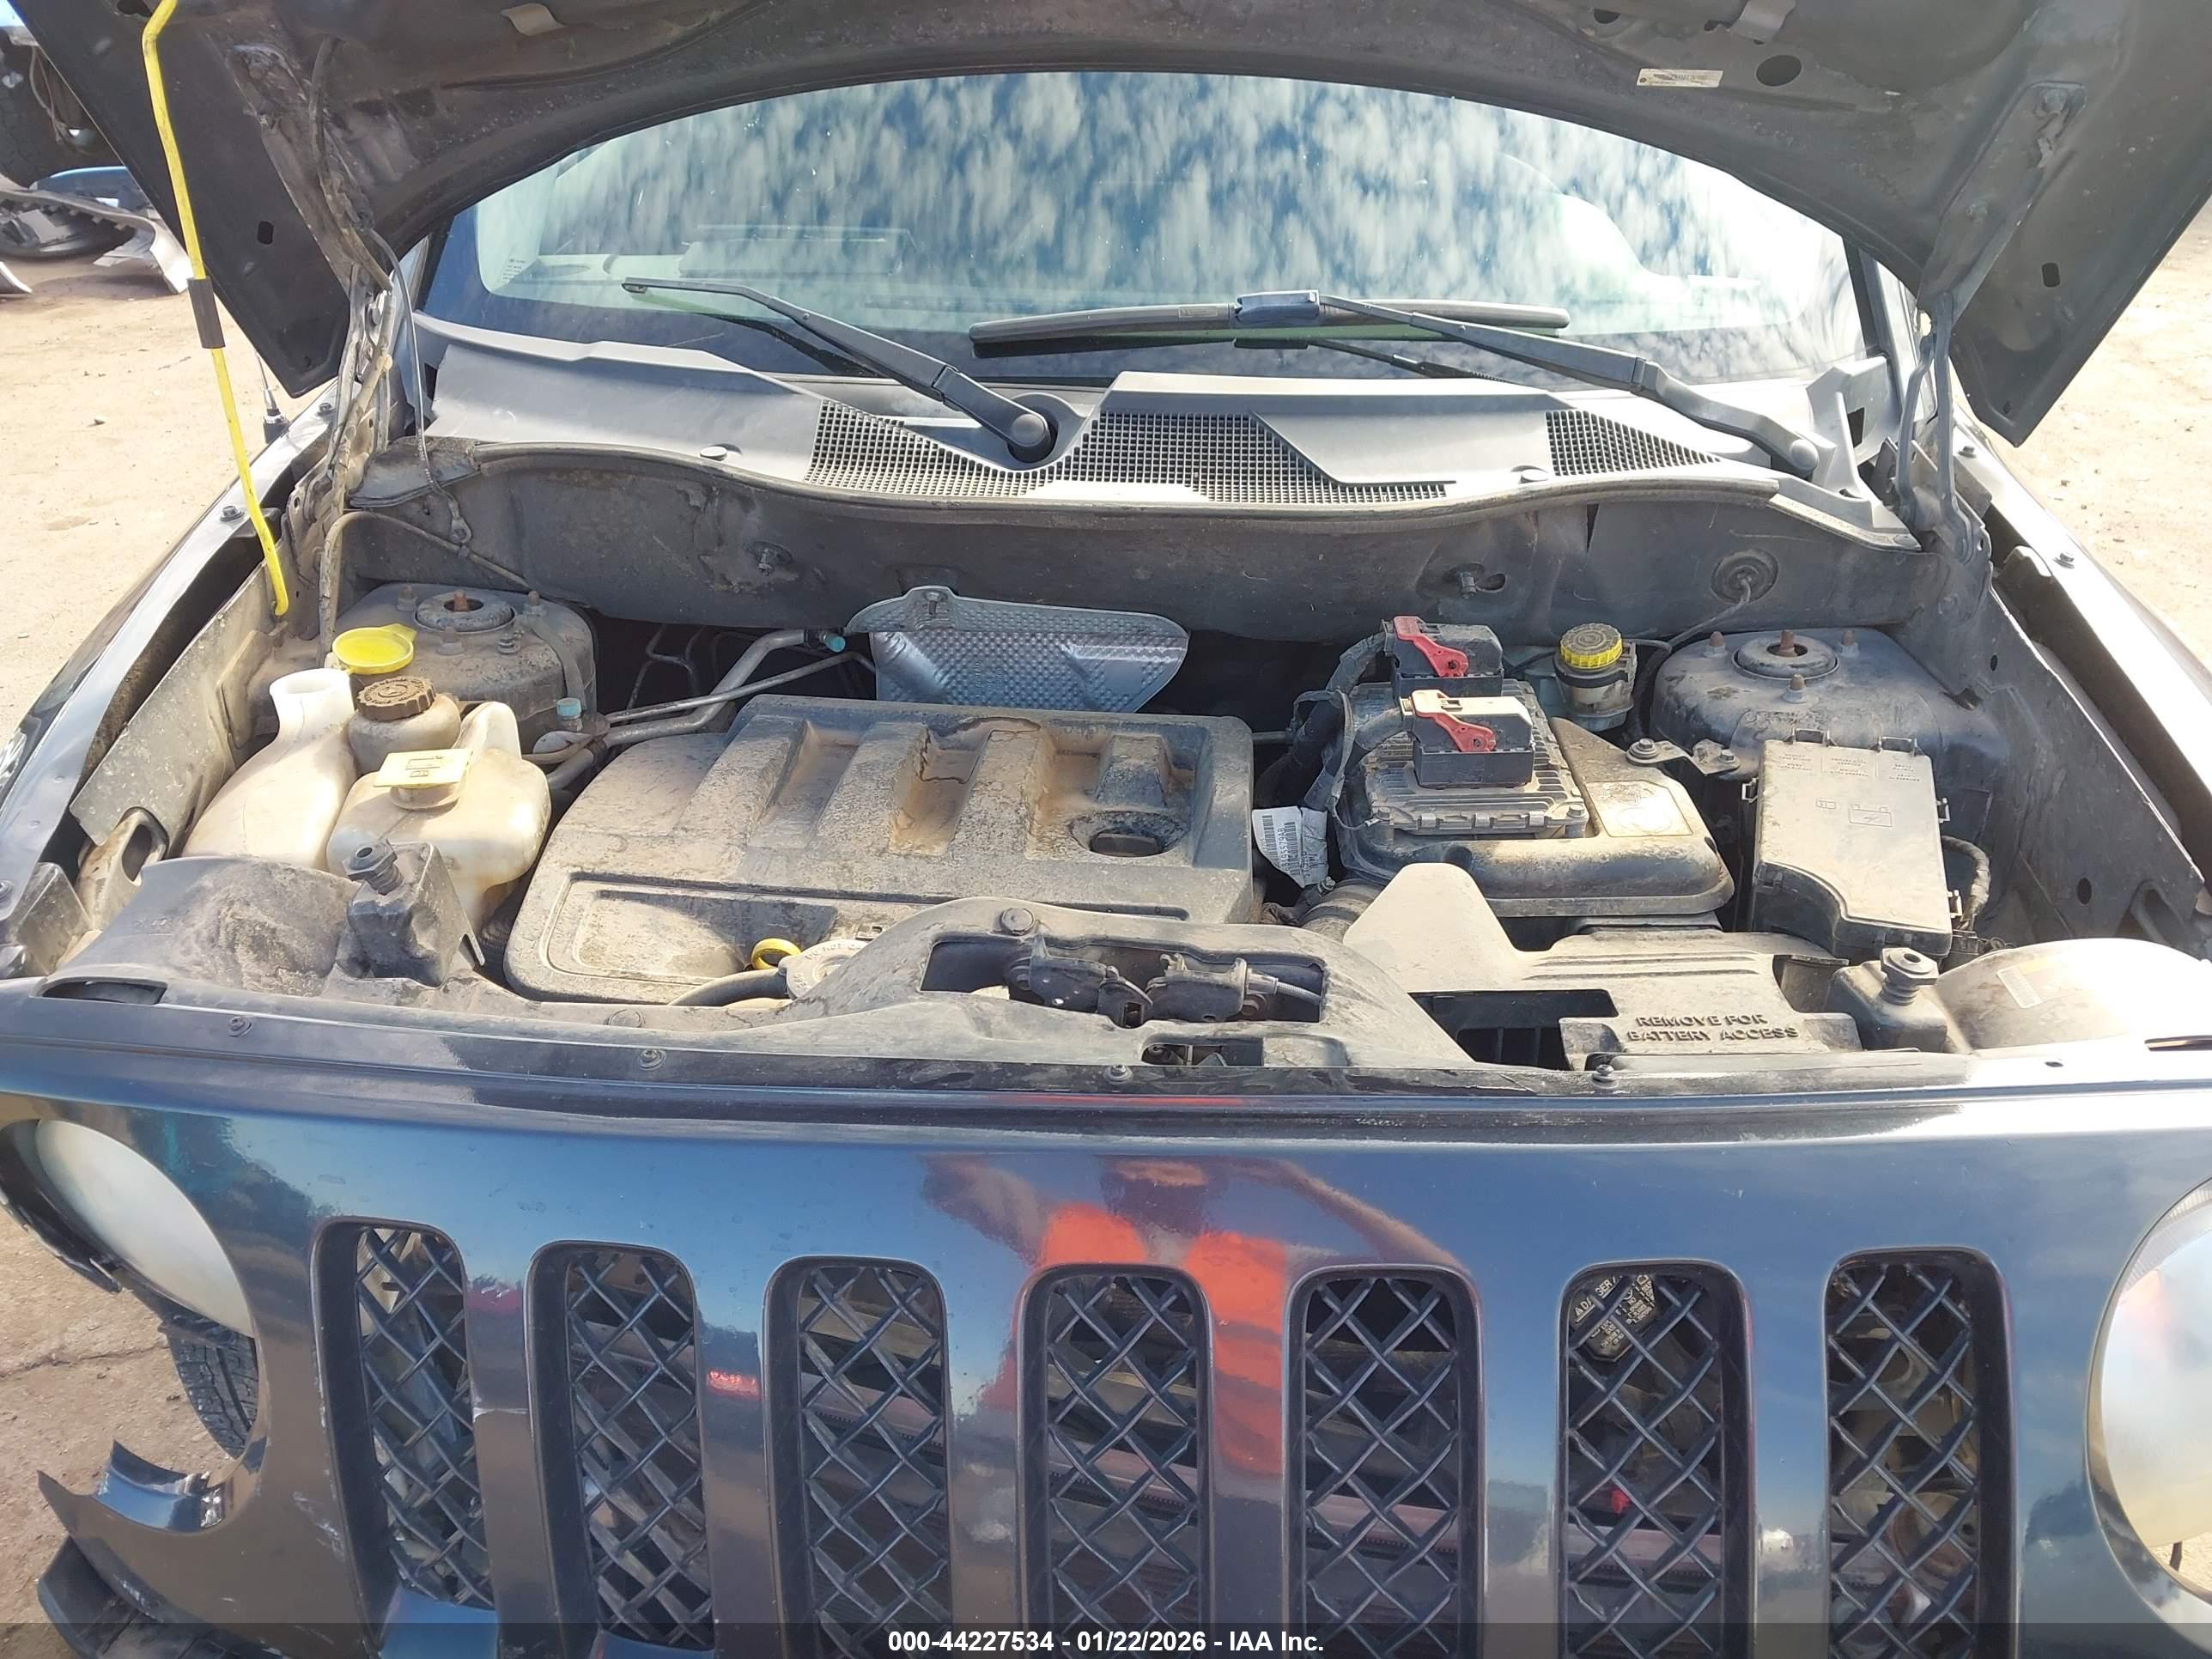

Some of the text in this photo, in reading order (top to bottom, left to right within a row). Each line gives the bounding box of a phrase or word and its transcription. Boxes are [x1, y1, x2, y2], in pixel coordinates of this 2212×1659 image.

[1635, 1014, 1768, 1027] REMOVE FOR
[1627, 1027, 1799, 1042] BATTERY ACCESS
